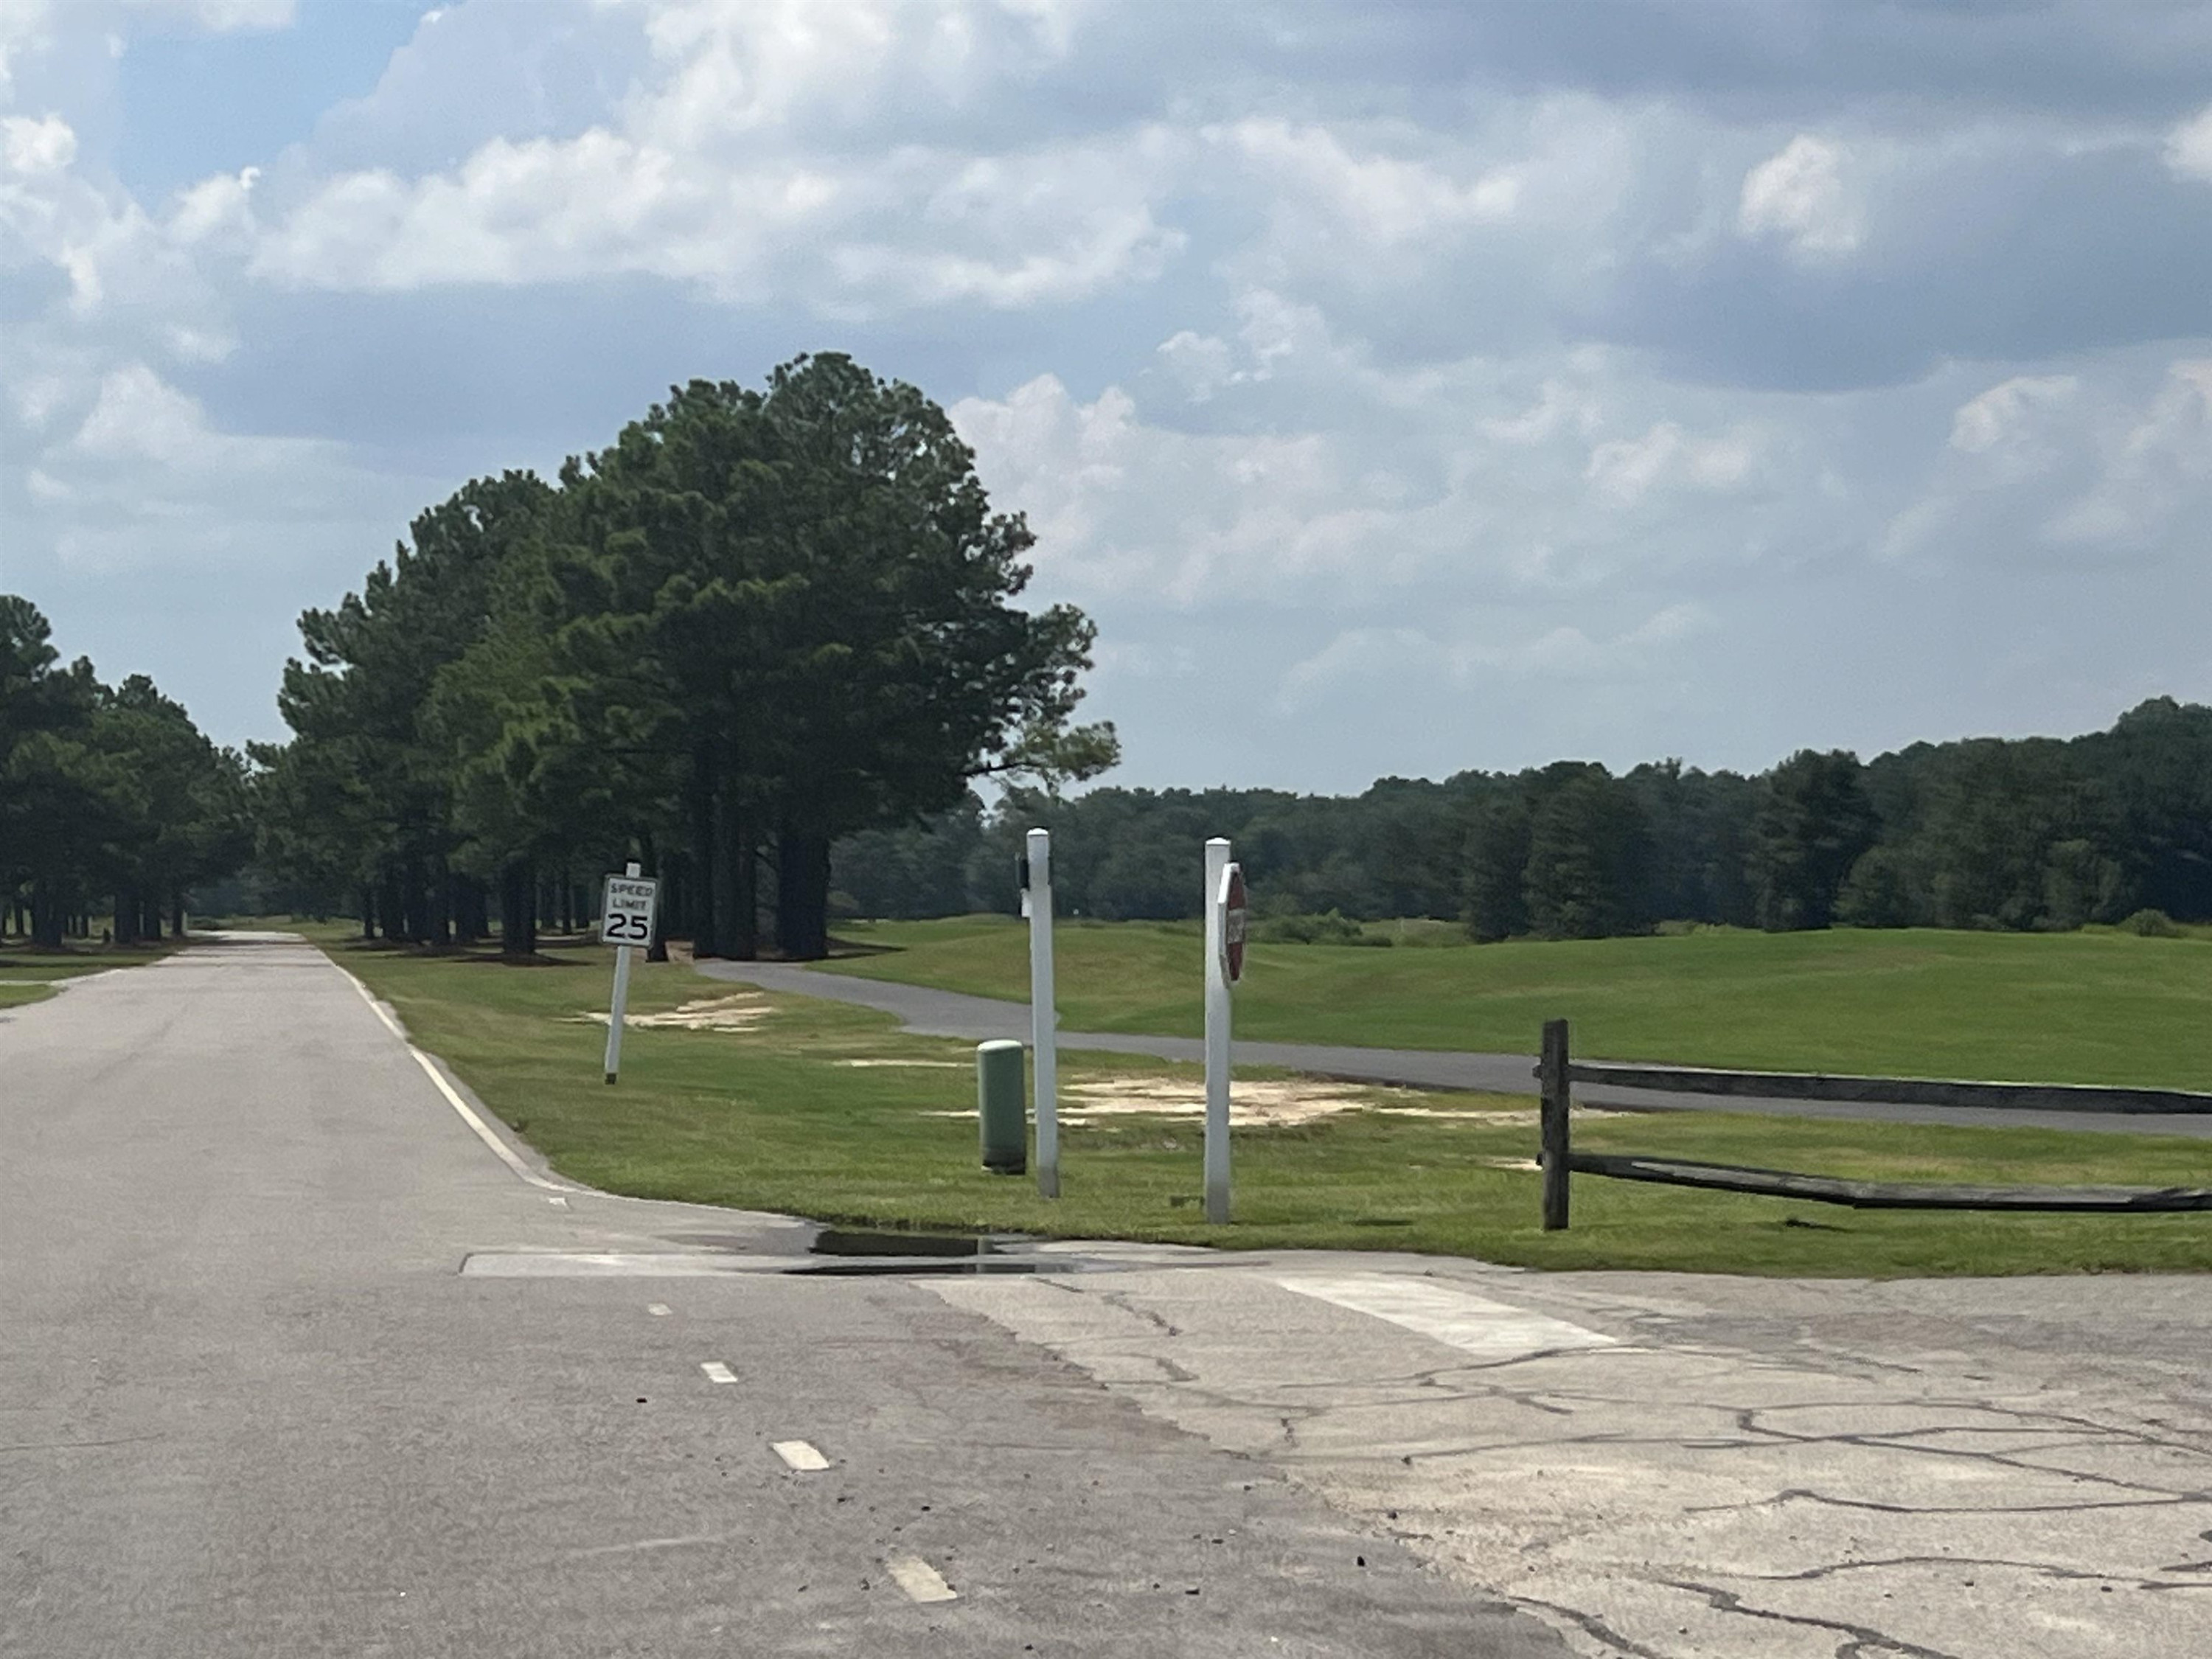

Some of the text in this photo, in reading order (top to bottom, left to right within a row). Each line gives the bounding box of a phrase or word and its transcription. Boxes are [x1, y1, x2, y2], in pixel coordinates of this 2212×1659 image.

[611, 883, 653, 897] SPEED
[613, 899, 647, 911] LIMIT
[606, 914, 648, 939] 25
